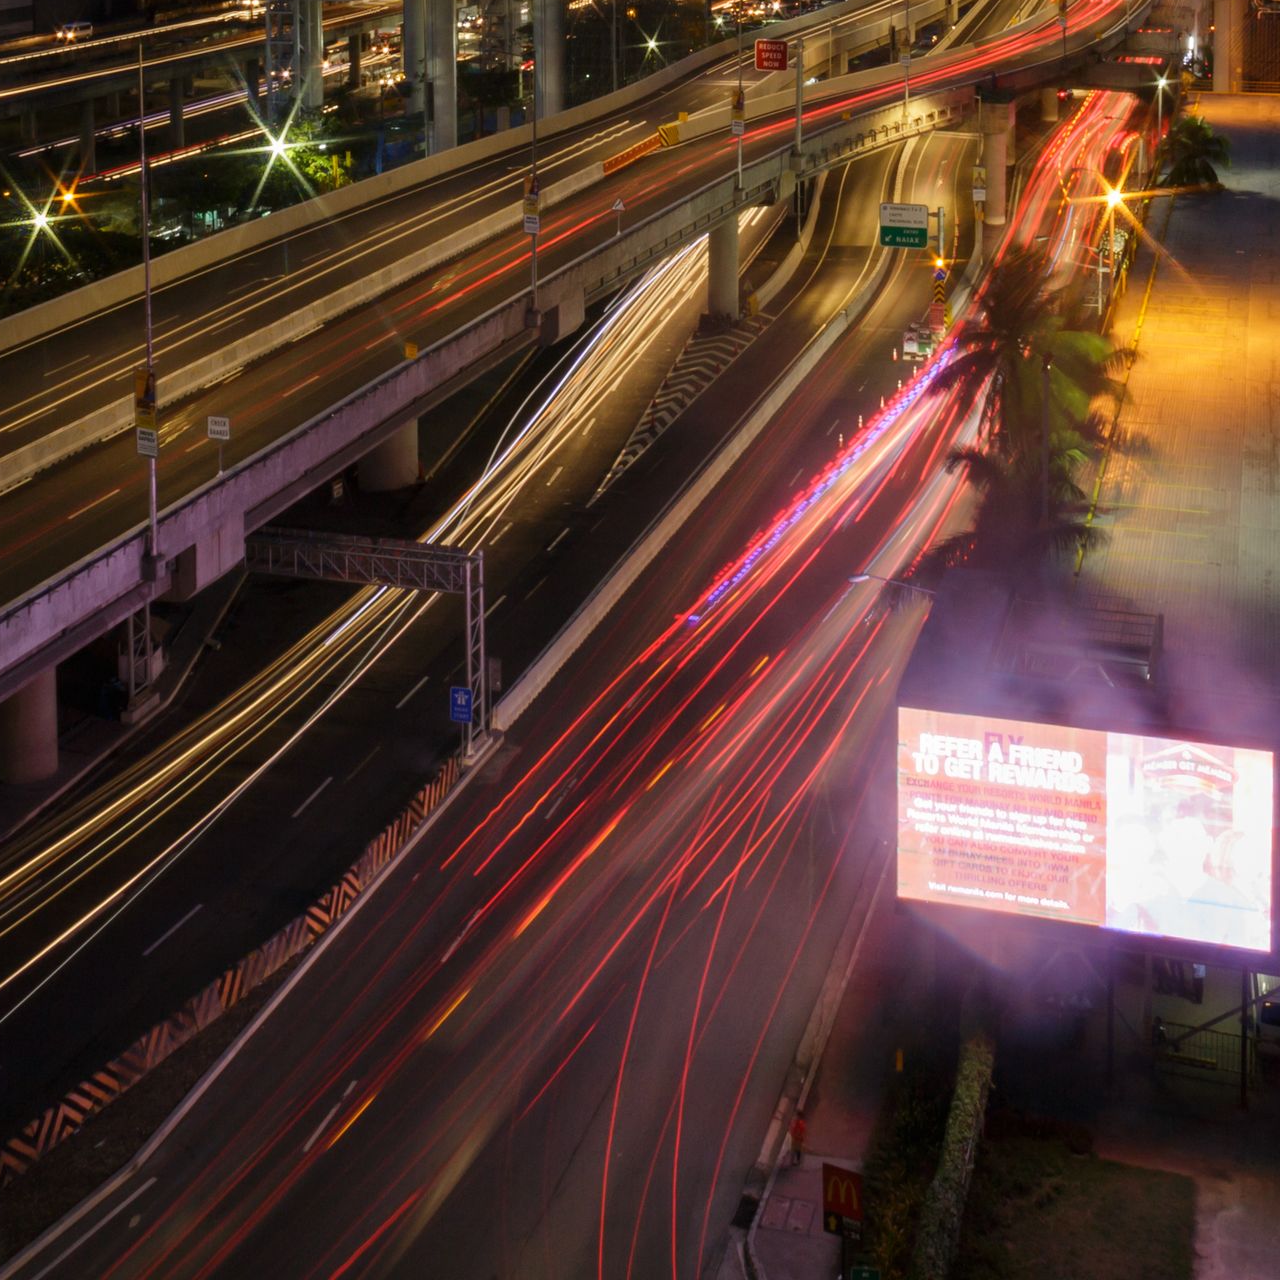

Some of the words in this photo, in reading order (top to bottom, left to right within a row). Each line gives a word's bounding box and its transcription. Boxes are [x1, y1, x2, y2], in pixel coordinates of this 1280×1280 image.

[919, 733, 983, 760] REFER
[988, 742, 1004, 764] A
[1008, 744, 1082, 773] FRIEND
[912, 752, 940, 775] TO
[944, 756, 984, 780] GET
[988, 762, 1090, 794] REWARDS
[1028, 792, 1062, 807] WORLD
[1064, 798, 1102, 811] MANILA
[996, 808, 1007, 818] to
[996, 866, 1008, 875] TO
